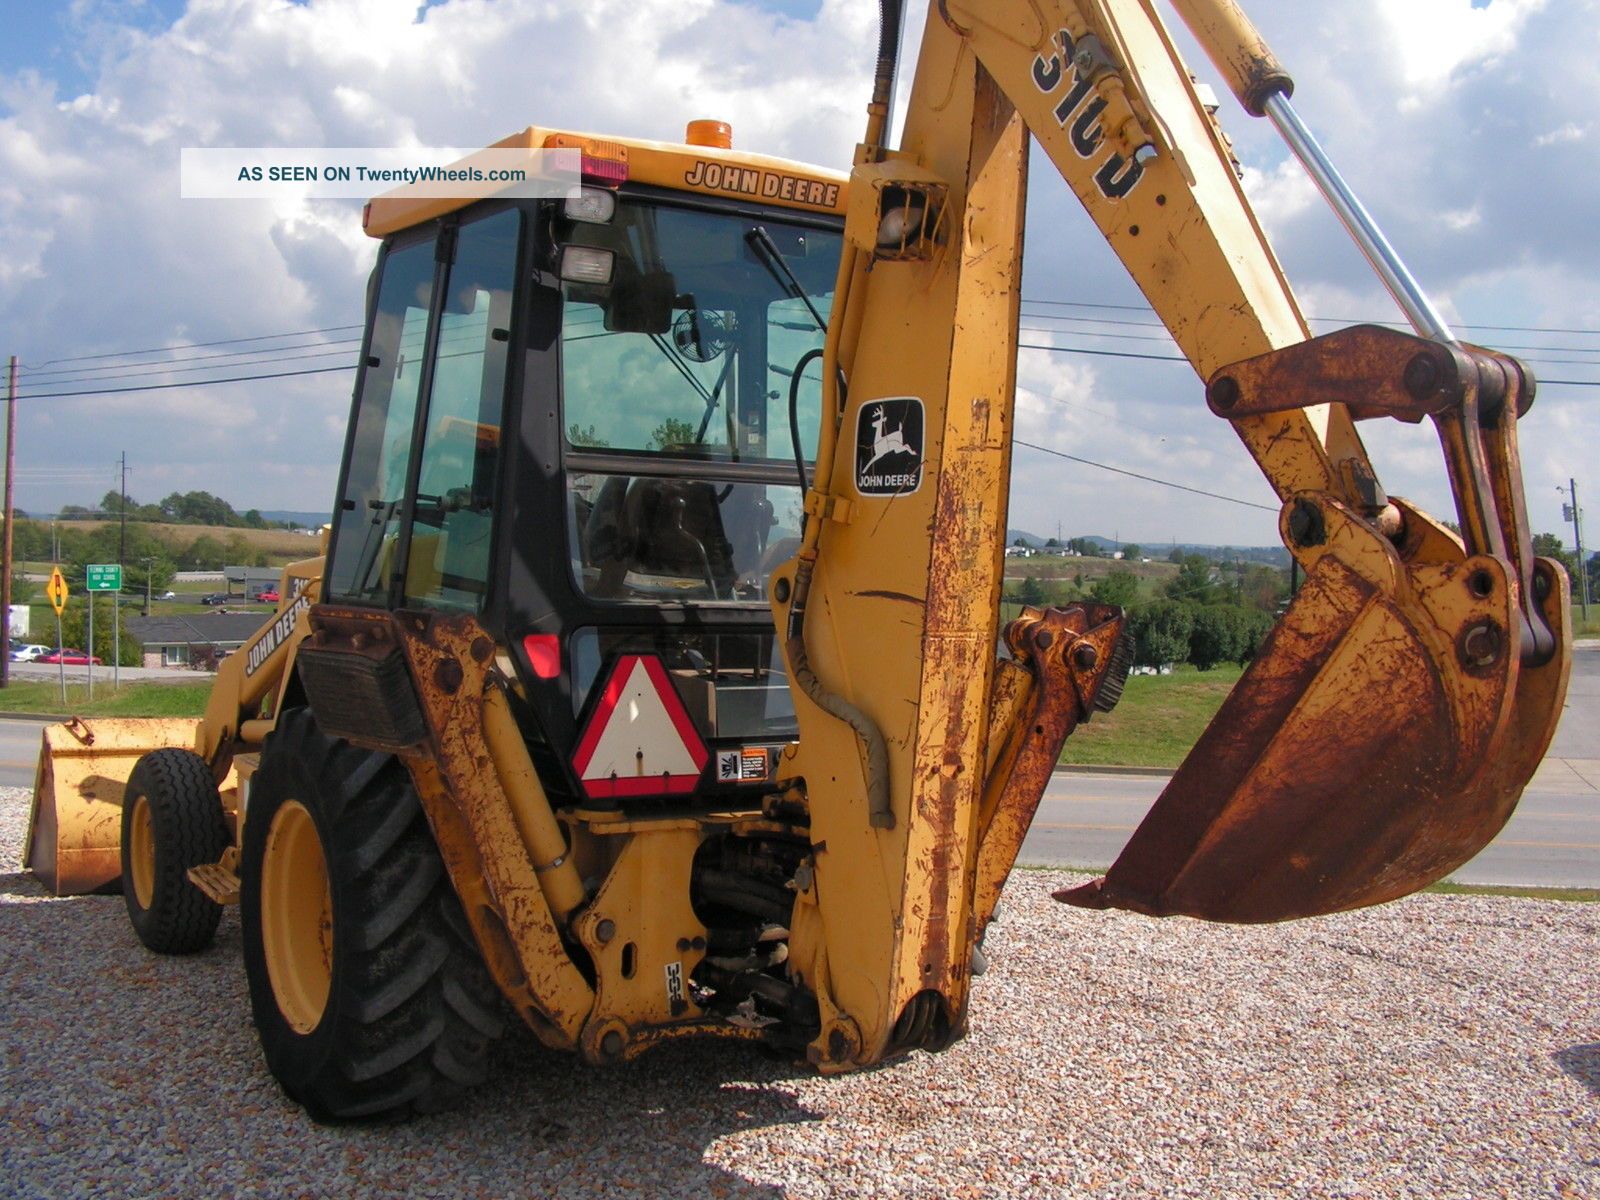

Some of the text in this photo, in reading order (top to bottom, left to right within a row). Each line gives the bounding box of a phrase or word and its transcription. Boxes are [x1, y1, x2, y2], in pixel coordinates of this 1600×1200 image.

[686, 161, 839, 207] JOHN DEERE
[858, 474, 916, 487] JOHN DEERE
[247, 633, 275, 675] JOHN
